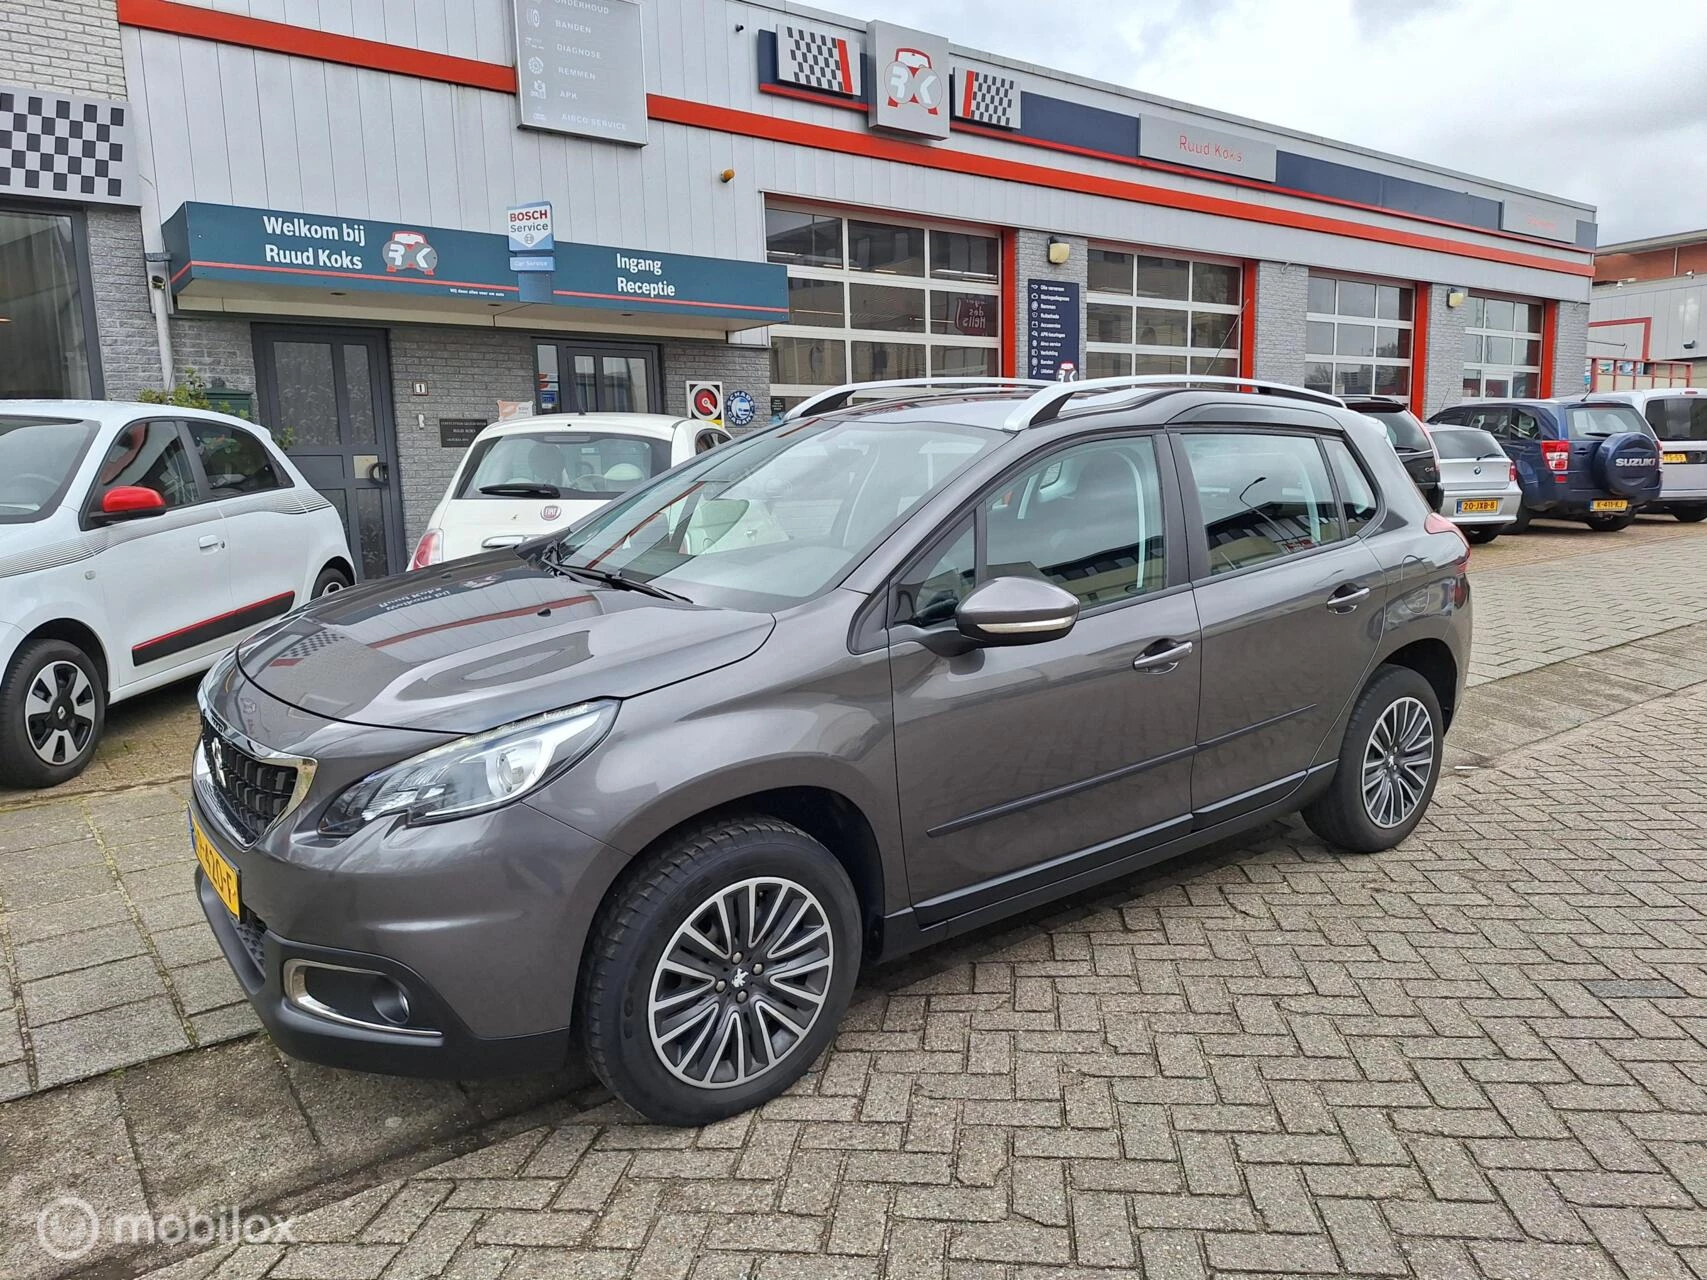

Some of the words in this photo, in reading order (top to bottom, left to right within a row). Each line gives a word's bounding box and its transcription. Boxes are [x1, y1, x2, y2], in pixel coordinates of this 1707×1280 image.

[555, 20, 591, 34] BANDEN
[556, 43, 601, 59] DIAGNOSE
[558, 66, 596, 81] REMMEN
[560, 90, 578, 100] APK
[591, 118, 626, 130] SERVICE
[1179, 135, 1210, 156] Ruud
[510, 210, 548, 222] BOSCH
[262, 215, 339, 241] Welkom
[342, 223, 366, 247] bij
[510, 222, 549, 233] Service
[265, 244, 314, 266] Ruud
[318, 250, 363, 270] Koks
[526, 259, 549, 267] Service
[616, 253, 662, 275] Ingang
[617, 277, 676, 298] Receptie
[1615, 458, 1656, 467] SUZUKI
